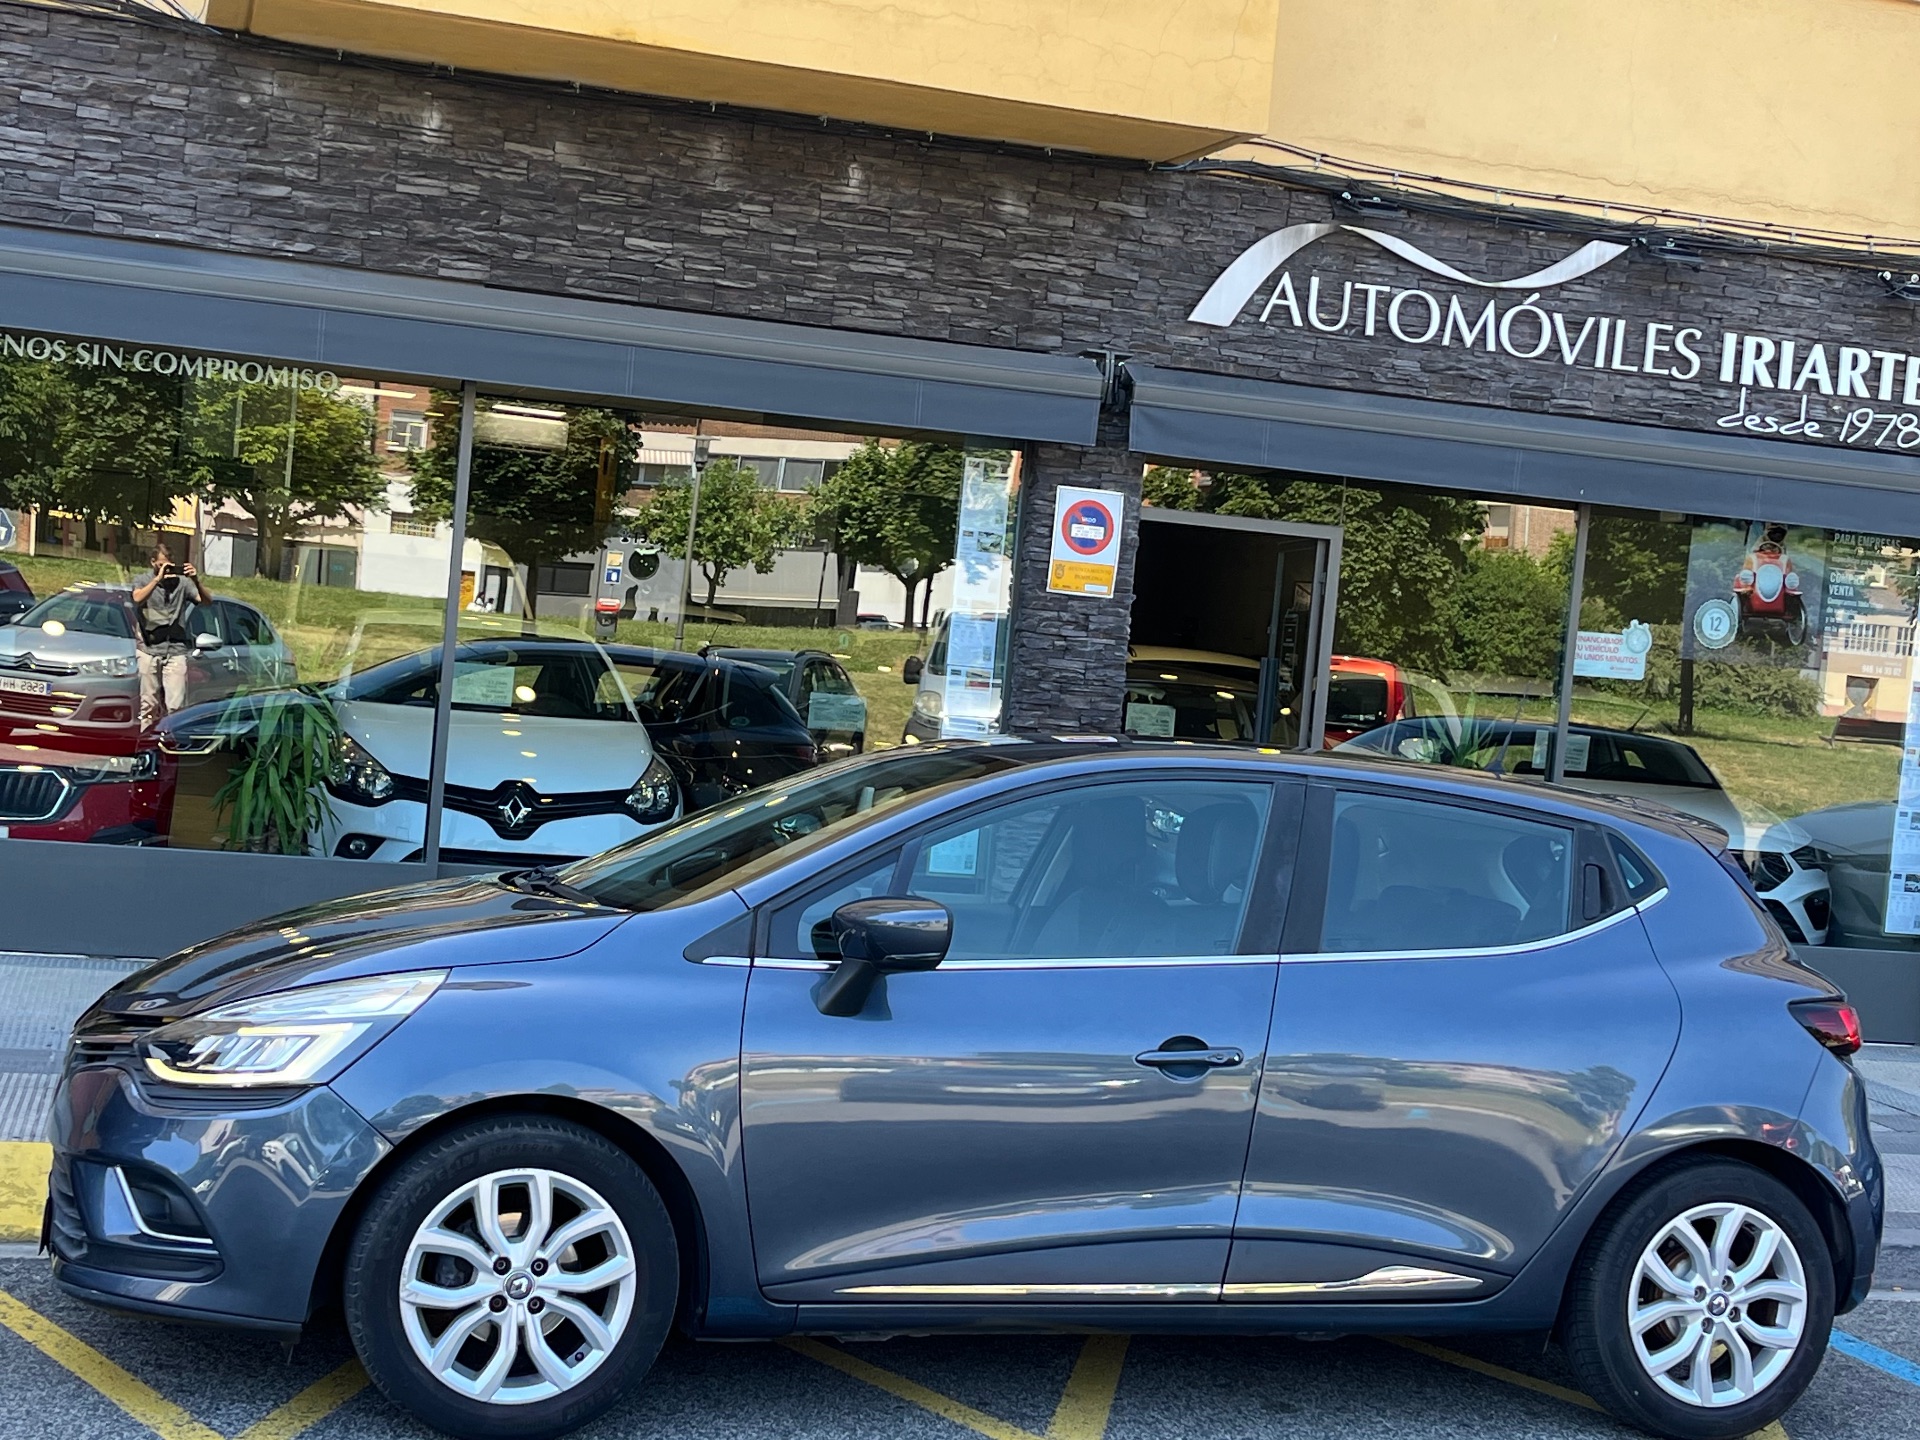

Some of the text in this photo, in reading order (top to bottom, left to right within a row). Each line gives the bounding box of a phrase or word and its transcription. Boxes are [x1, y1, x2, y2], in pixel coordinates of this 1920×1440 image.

[1259, 271, 1920, 407] AUTOMÓVILES IRIARTE
[0, 332, 339, 394] NOS SIN COMPROMISO
[1716, 386, 1920, 449] desde 1978
[1834, 532, 1902, 549] PARA EMPRESAS
[1828, 584, 1855, 597] VENTA
[1709, 616, 1723, 633] 12
